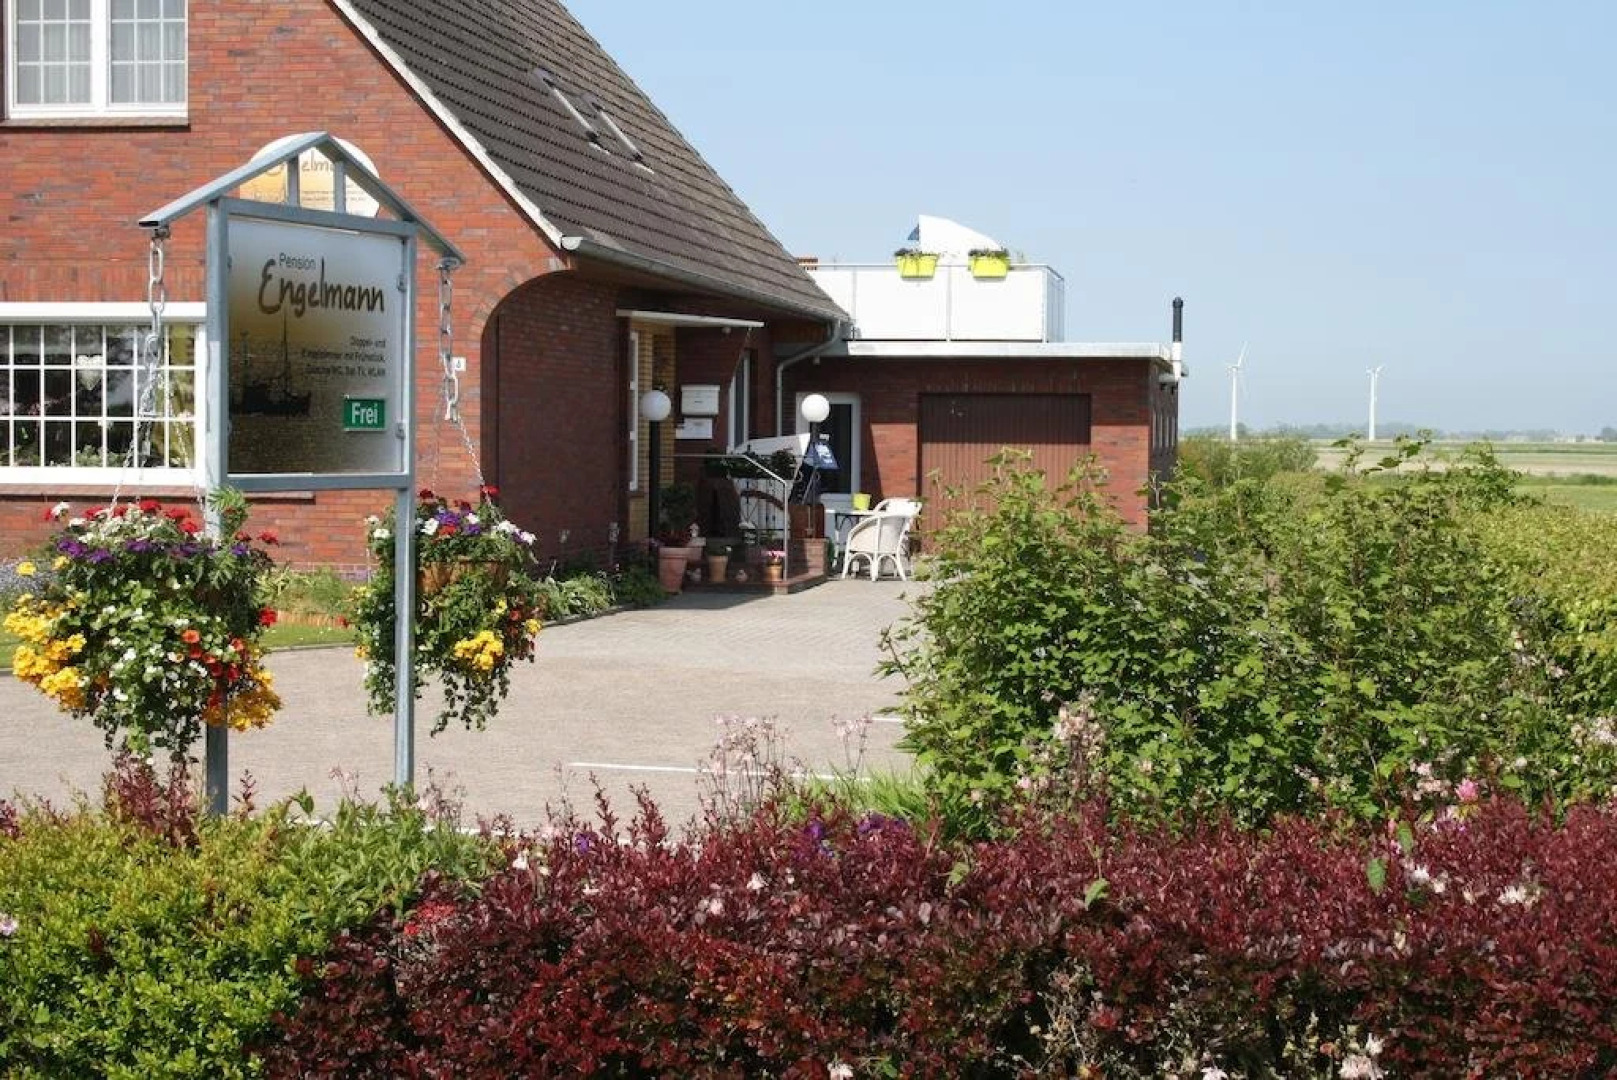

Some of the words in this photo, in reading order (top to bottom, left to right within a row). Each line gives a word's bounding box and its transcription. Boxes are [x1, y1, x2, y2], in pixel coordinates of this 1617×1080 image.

[279, 252, 317, 270] Pension
[258, 256, 385, 318] Engelmann
[351, 402, 379, 424] Frei
